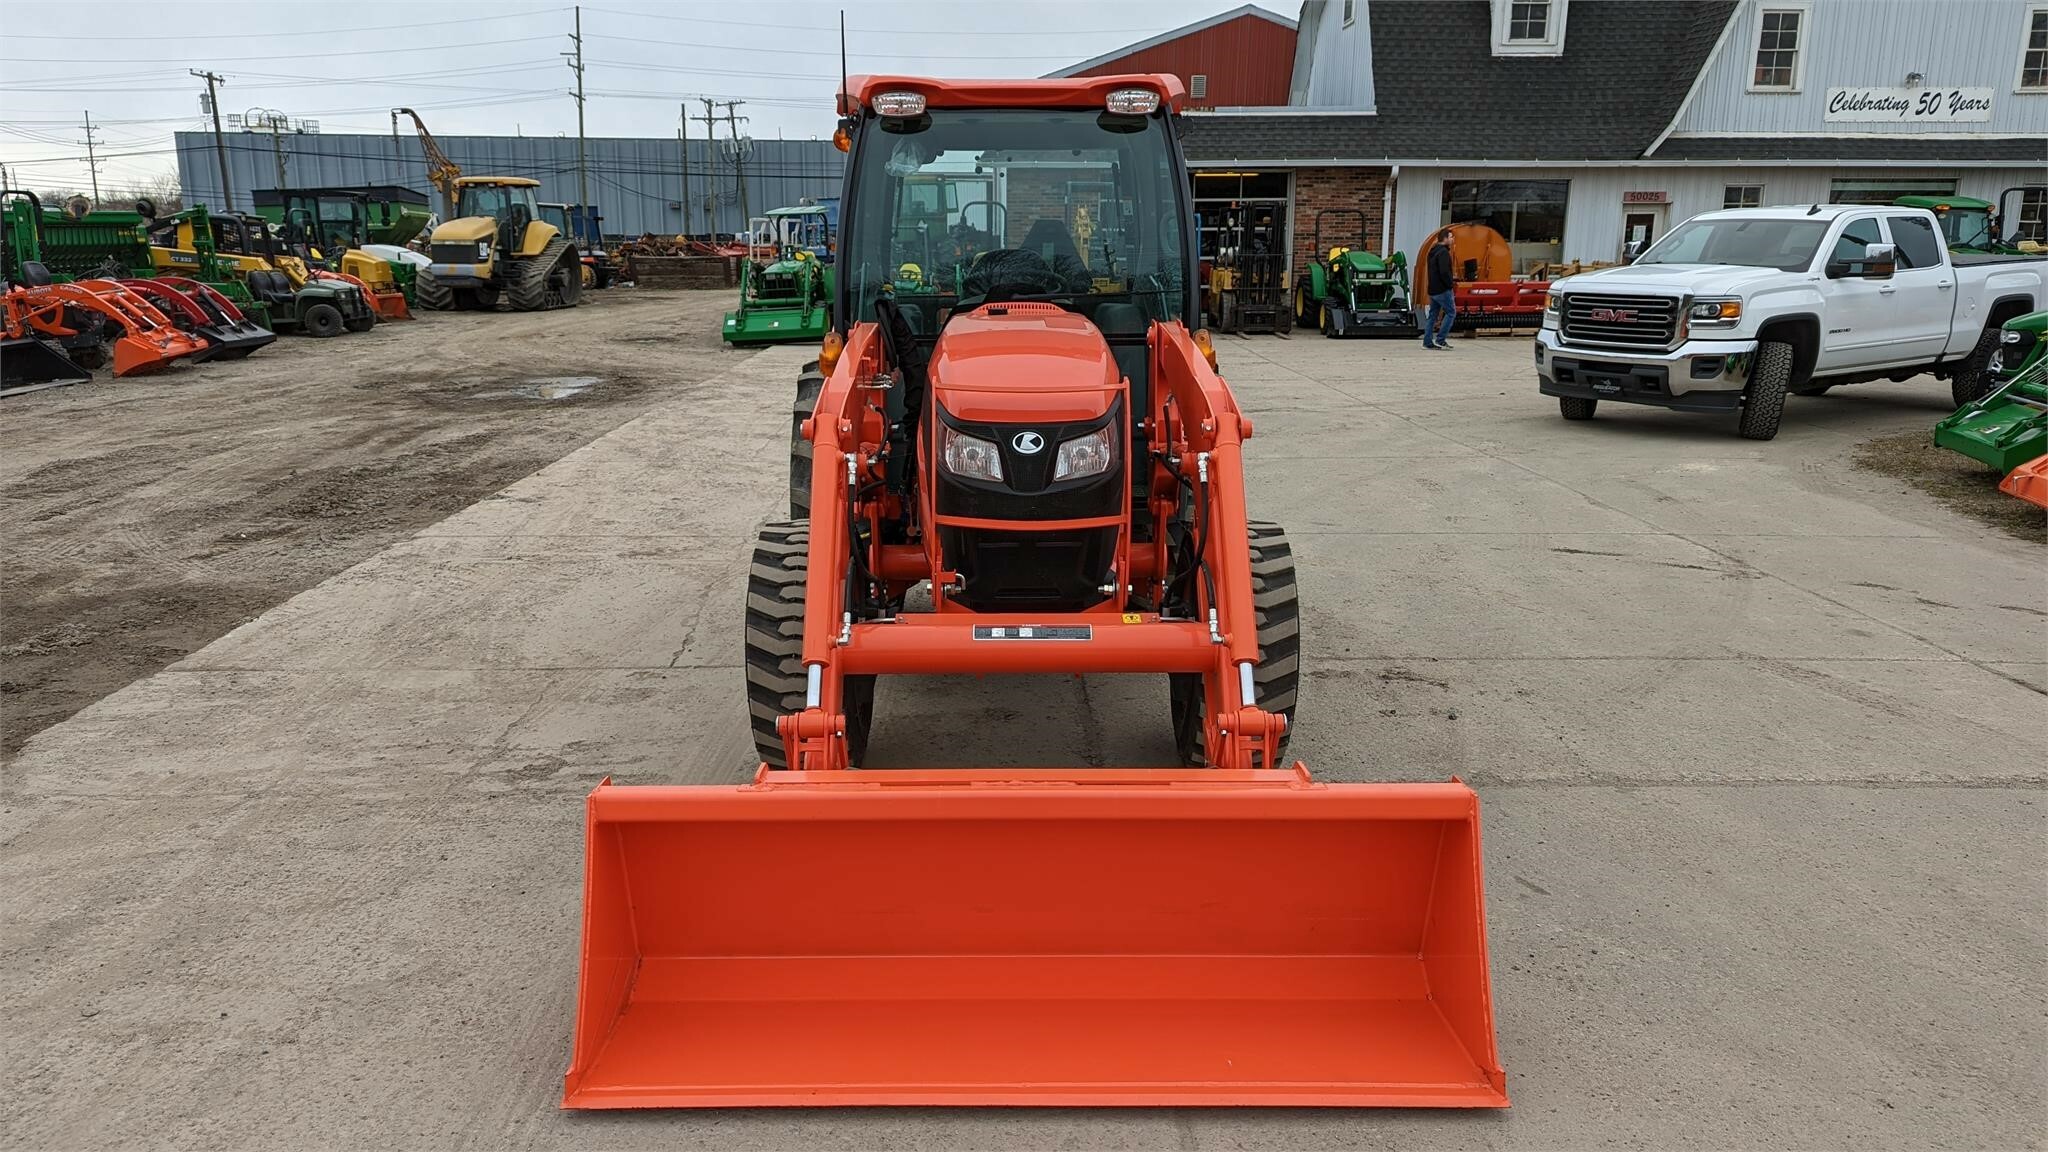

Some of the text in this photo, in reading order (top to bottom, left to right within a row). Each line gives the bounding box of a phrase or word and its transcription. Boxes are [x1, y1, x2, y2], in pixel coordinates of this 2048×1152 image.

[1829, 90, 1990, 118] Celebrating 50 Years
[1630, 191, 1660, 201] 50025
[1591, 308, 1639, 323] GMC
